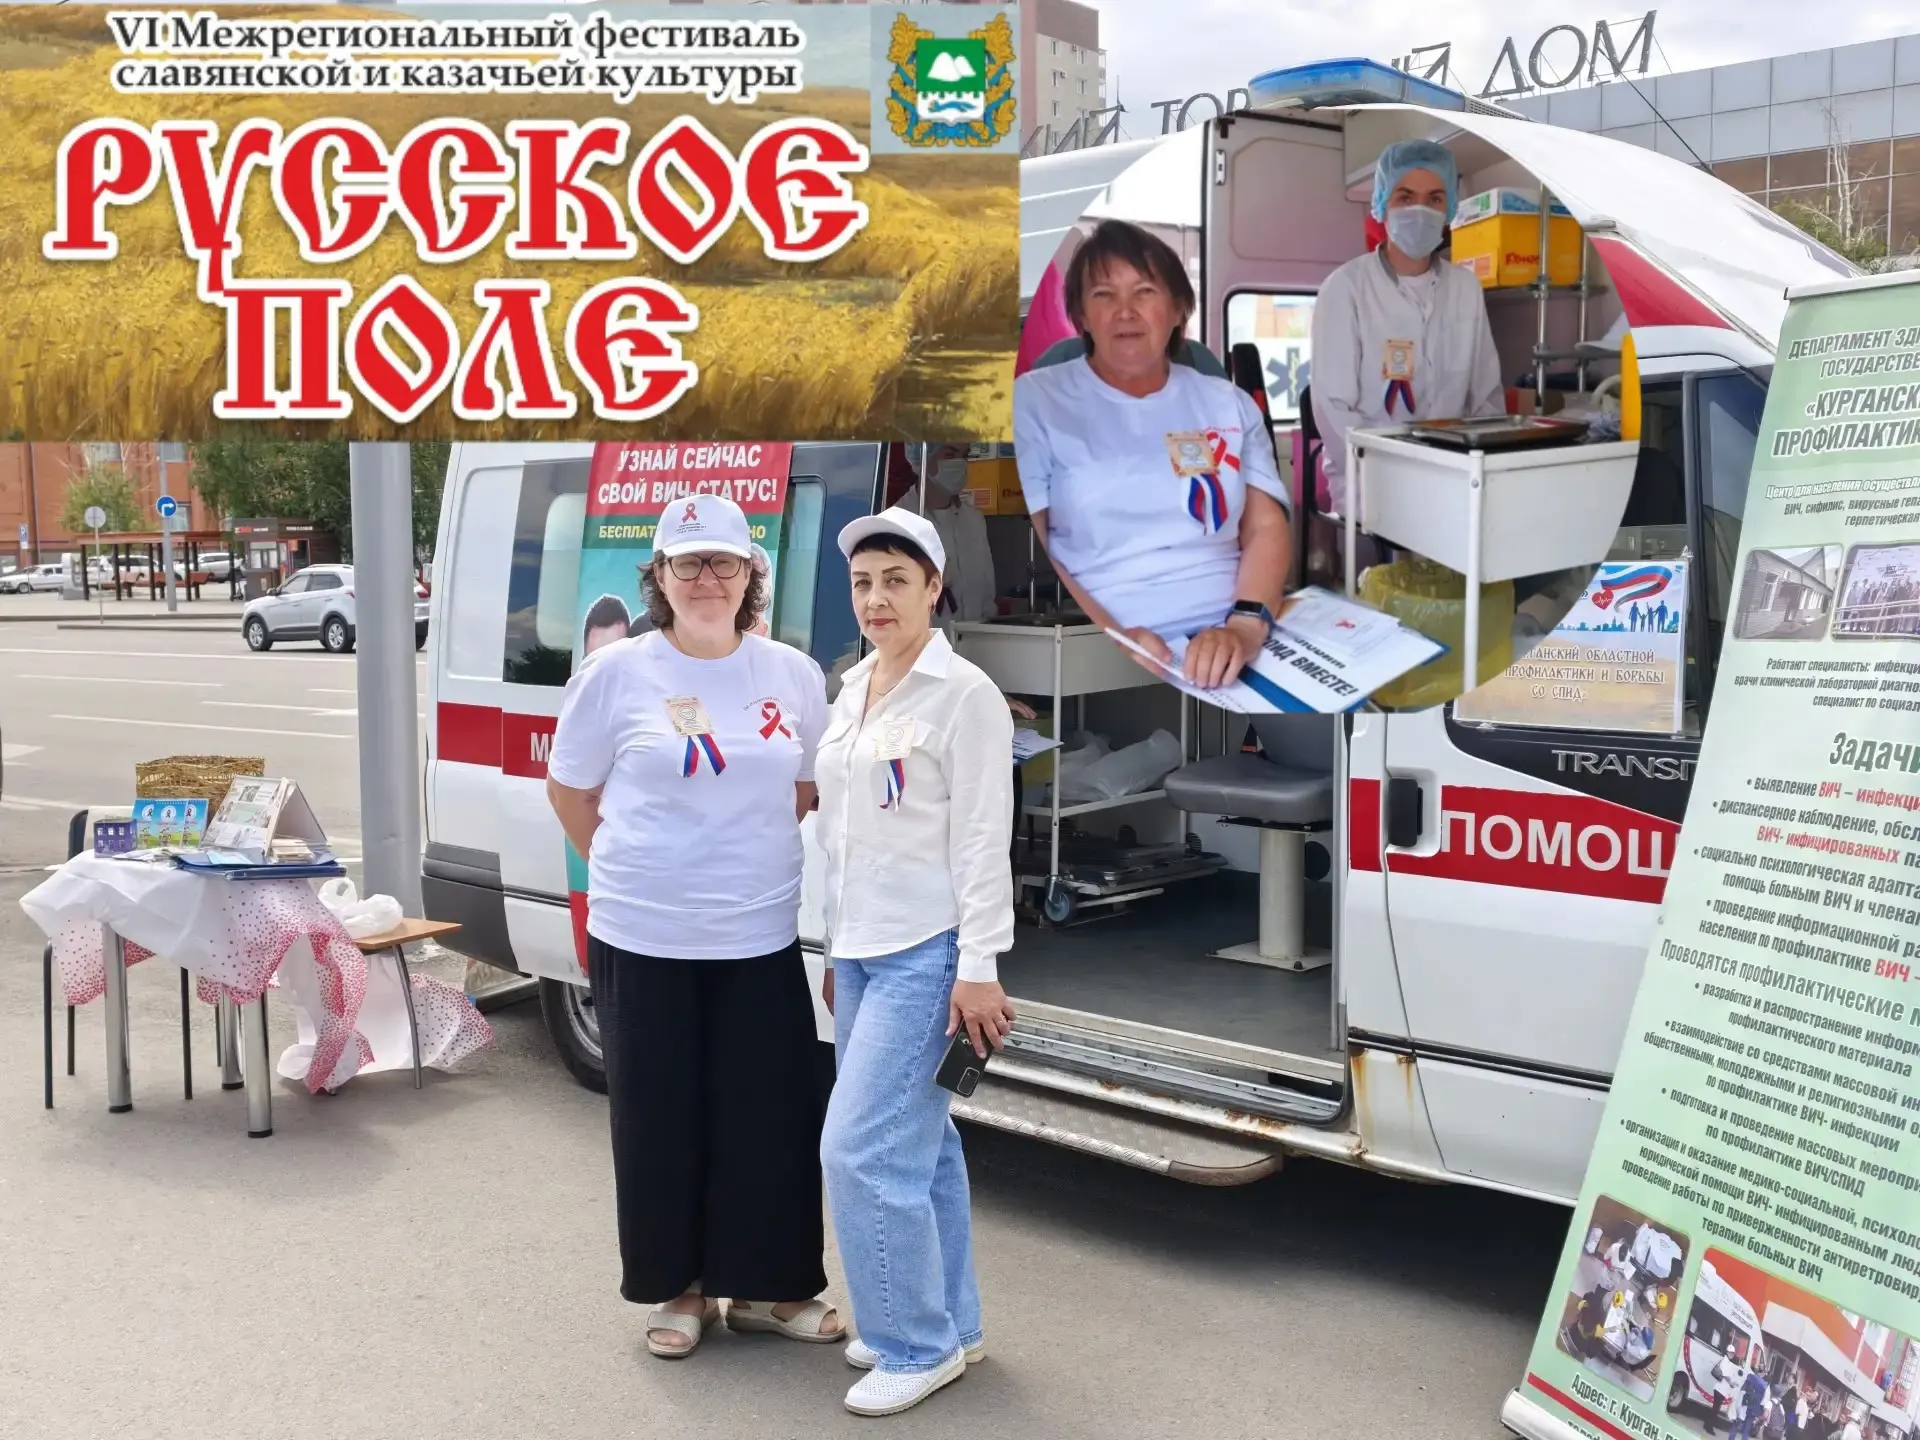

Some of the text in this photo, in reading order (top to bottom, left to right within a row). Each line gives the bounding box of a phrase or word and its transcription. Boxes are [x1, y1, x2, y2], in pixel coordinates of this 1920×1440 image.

[1474, 10, 1657, 99] ДОМ
[1788, 327, 1920, 359] ДЕПАРТАМЕНТ ЗД
[1820, 352, 1920, 378] ГОСУДАРСТВЕ
[1806, 384, 1920, 418] «КУРГАНСК
[617, 443, 762, 472] УЗНАЙ СЕЙЧАС
[598, 478, 647, 504] СВОЙ
[1766, 476, 1920, 500] Центр для населения осуществл
[1848, 498, 1900, 510] вирусные
[1844, 513, 1920, 527] герпетическая
[1505, 665, 1595, 680] ПРОФИЛАКТИКИ
[1616, 671, 1665, 684] БОРЬБЫ
[1586, 648, 1655, 663] ОБЛАСТНОЙ
[1766, 658, 1807, 671] Работают
[1808, 660, 1871, 673] специалисты:
[1290, 656, 1360, 697] ВМЕСТЕ!
[1532, 685, 1545, 697] СО
[1734, 673, 1920, 693] врачи клинической лабораторной диагно
[1812, 694, 1865, 708] специалист
[1865, 697, 1877, 708] по
[1754, 777, 1817, 797] выявление
[1818, 781, 1842, 799] ВИЧ
[1718, 799, 1797, 822] диспансерное
[1798, 808, 1879, 836] наблюдение,
[1700, 846, 1757, 868] социально
[1759, 854, 1866, 888] психологическая
[1786, 831, 1901, 864] инфицированных
[1723, 873, 1766, 894] помощь
[1768, 879, 1821, 904] больным
[1823, 889, 1852, 911] ВИЧ
[1854, 898, 1865, 913] и
[1713, 899, 1777, 925] проведение
[1776, 910, 1900, 953] информационной
[1699, 919, 1912, 982] населения по профилактике ВИЧ
[1660, 938, 1737, 976] Проводятся
[1738, 963, 1905, 1022] профилактические
[1702, 982, 1752, 1007] разработка
[1753, 998, 1761, 1009] и
[1763, 998, 1863, 1040] распространение
[1670, 1021, 1745, 1054] взаимодействие
[1747, 1046, 1760, 1060] со
[1762, 1050, 1831, 1083] средствами
[1833, 1073, 1899, 1104] массовой
[1728, 1010, 1913, 1078] профилактического материала
[1644, 1031, 1715, 1067] общественными,
[1716, 1057, 1796, 1094] молодежными
[1797, 1083, 1806, 1096] и
[1808, 1087, 1907, 1131] религиозными
[1670, 1089, 1718, 1117] подготовка
[1719, 1108, 1728, 1121] и
[1729, 1111, 1794, 1146] проведение
[1796, 1136, 1858, 1170] массовых
[1705, 1073, 1716, 1087] по
[1717, 1078, 1799, 1117] профилактике
[1830, 1118, 1901, 1152] инфекции
[1625, 1119, 1680, 1152] организация
[1680, 1140, 1687, 1153] и
[1687, 1145, 1738, 1175] оказание
[1739, 1166, 1858, 1227] медико-социальной,
[1705, 1125, 1866, 1198] по профилактике ВИЧ/СПИД
[1639, 1145, 1700, 1182] юридической
[1701, 1173, 1745, 1200] помощи
[1775, 1204, 1889, 1262] инфицированным
[1621, 1159, 1920, 1303] проведение работы по приверженности антиретровир
[1702, 1217, 1823, 1282] терапии больных ВИЧ
[1571, 1373, 1608, 1410] Адрес:
[1608, 1400, 1617, 1416] г.
